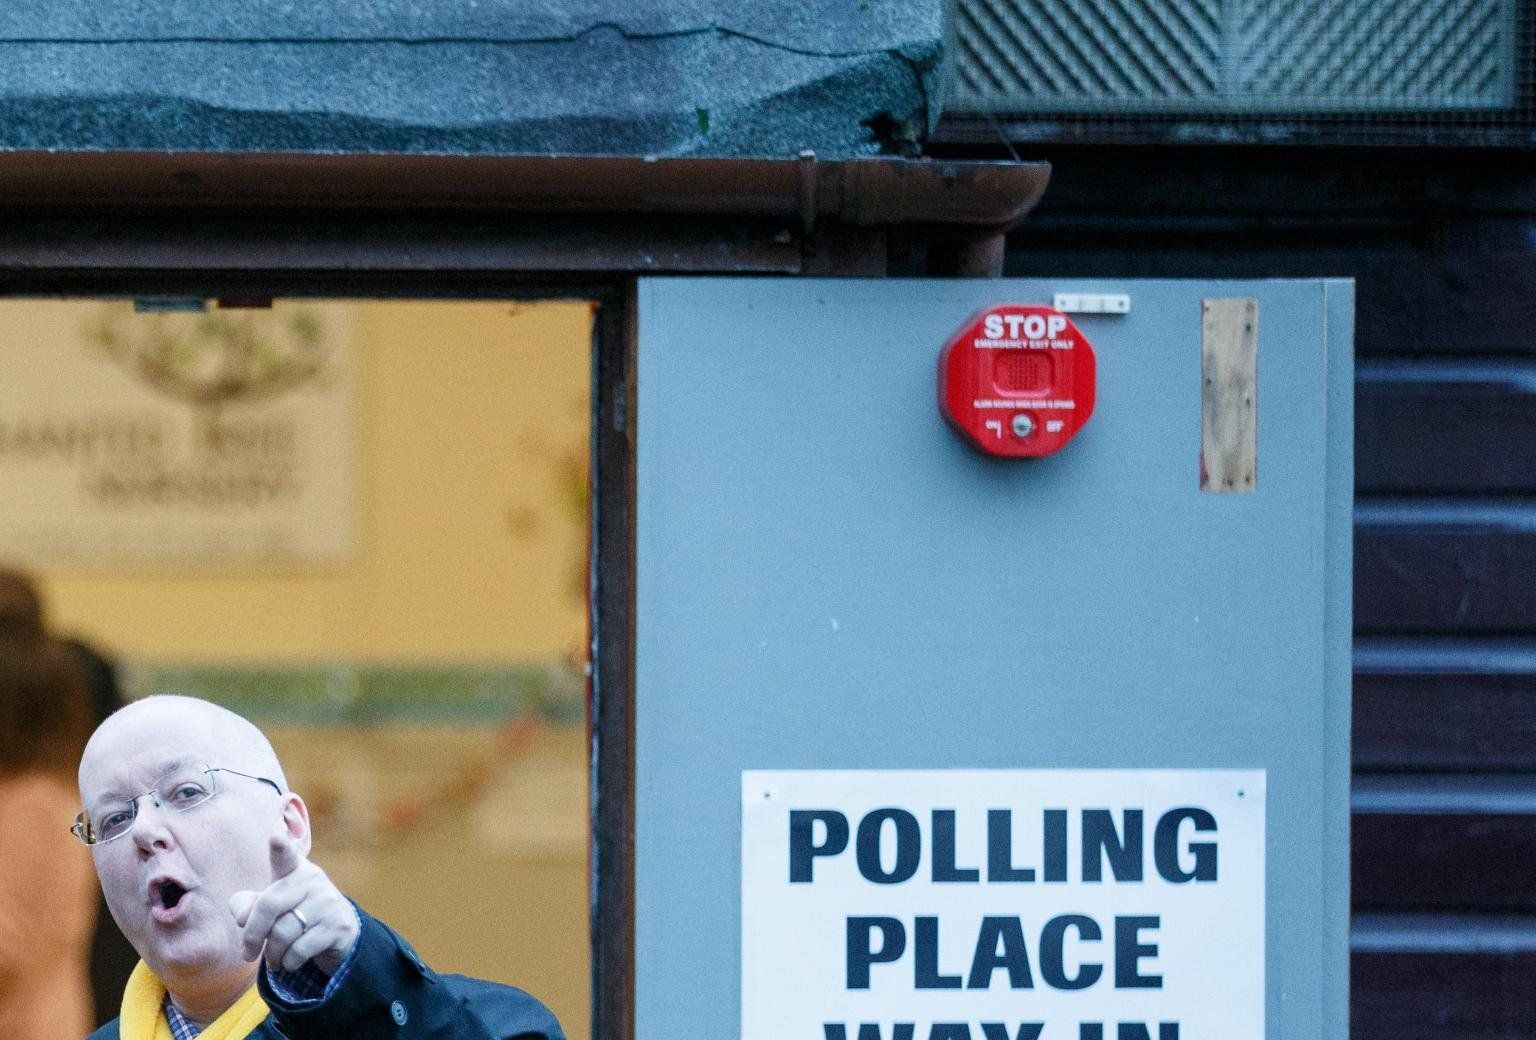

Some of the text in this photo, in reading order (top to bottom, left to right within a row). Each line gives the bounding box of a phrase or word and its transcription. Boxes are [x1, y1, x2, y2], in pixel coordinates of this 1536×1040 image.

[983, 313, 1067, 340] STOP
[789, 806, 1219, 885] POLLING
[846, 914, 1164, 991] PLACE
